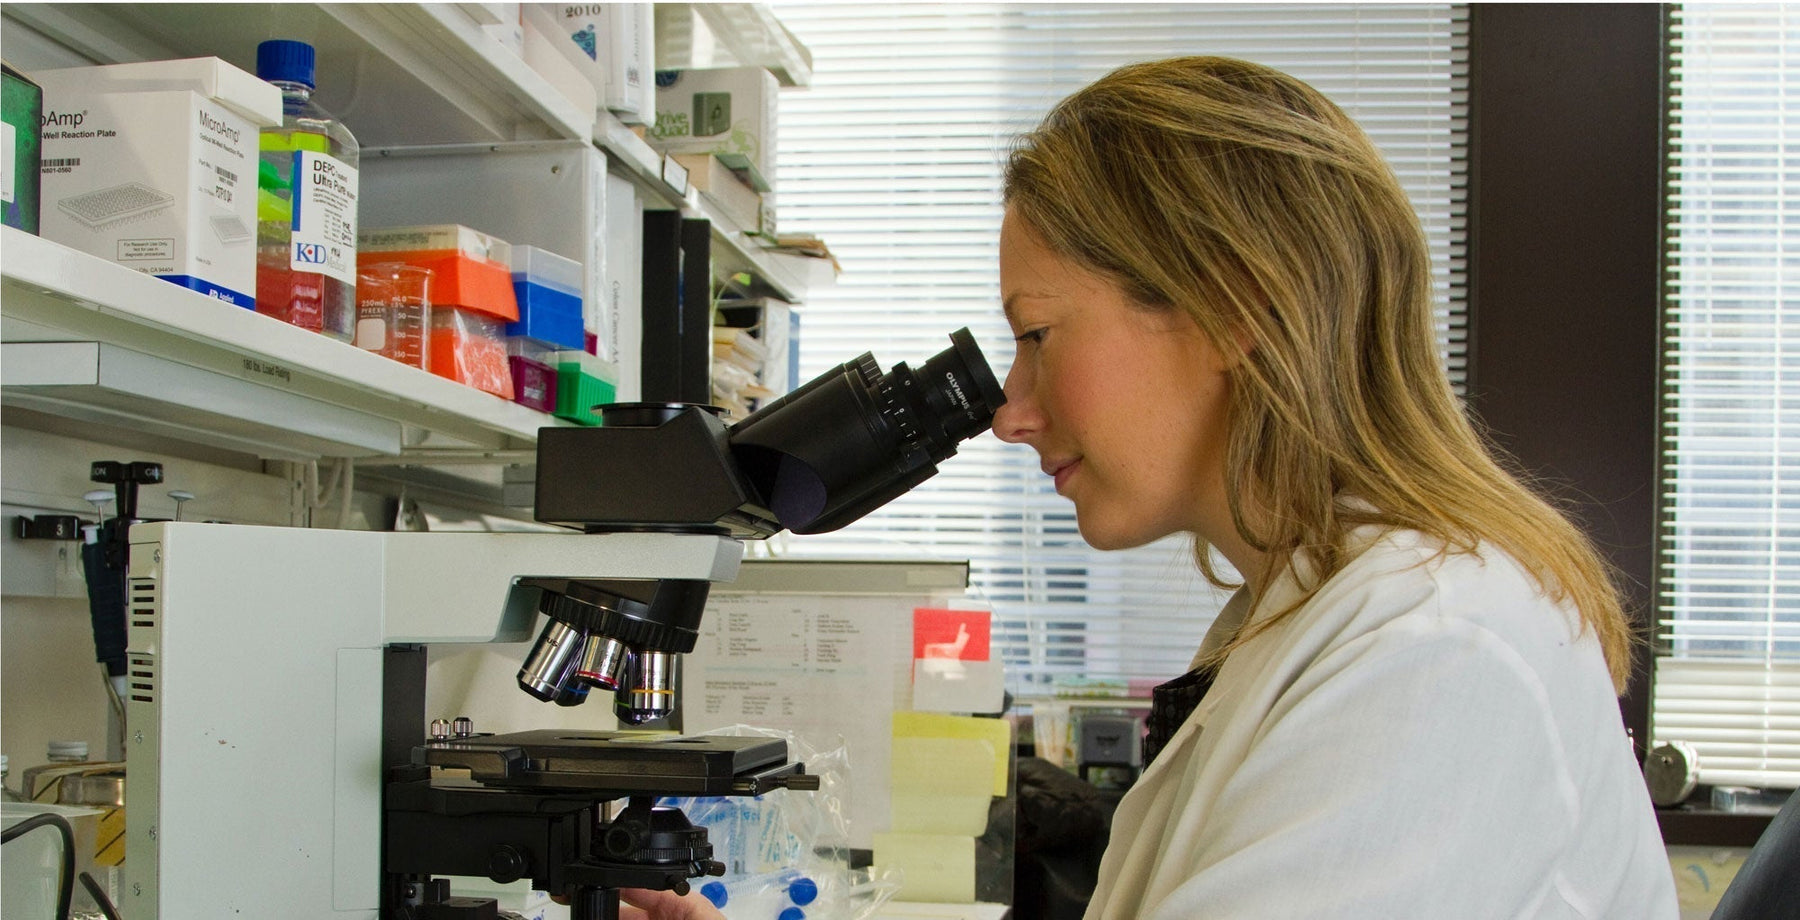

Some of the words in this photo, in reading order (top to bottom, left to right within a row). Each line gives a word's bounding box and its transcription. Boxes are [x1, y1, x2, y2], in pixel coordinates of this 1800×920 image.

[565, 4, 601, 18] 2010
[61, 130, 95, 139] Reaction
[96, 129, 117, 138] Plate
[650, 123, 689, 141] Quad
[313, 173, 332, 189] Ultra
[397, 312, 407, 320] 50
[945, 371, 970, 410] OLYMPUS
[56, 523, 63, 537] 3
